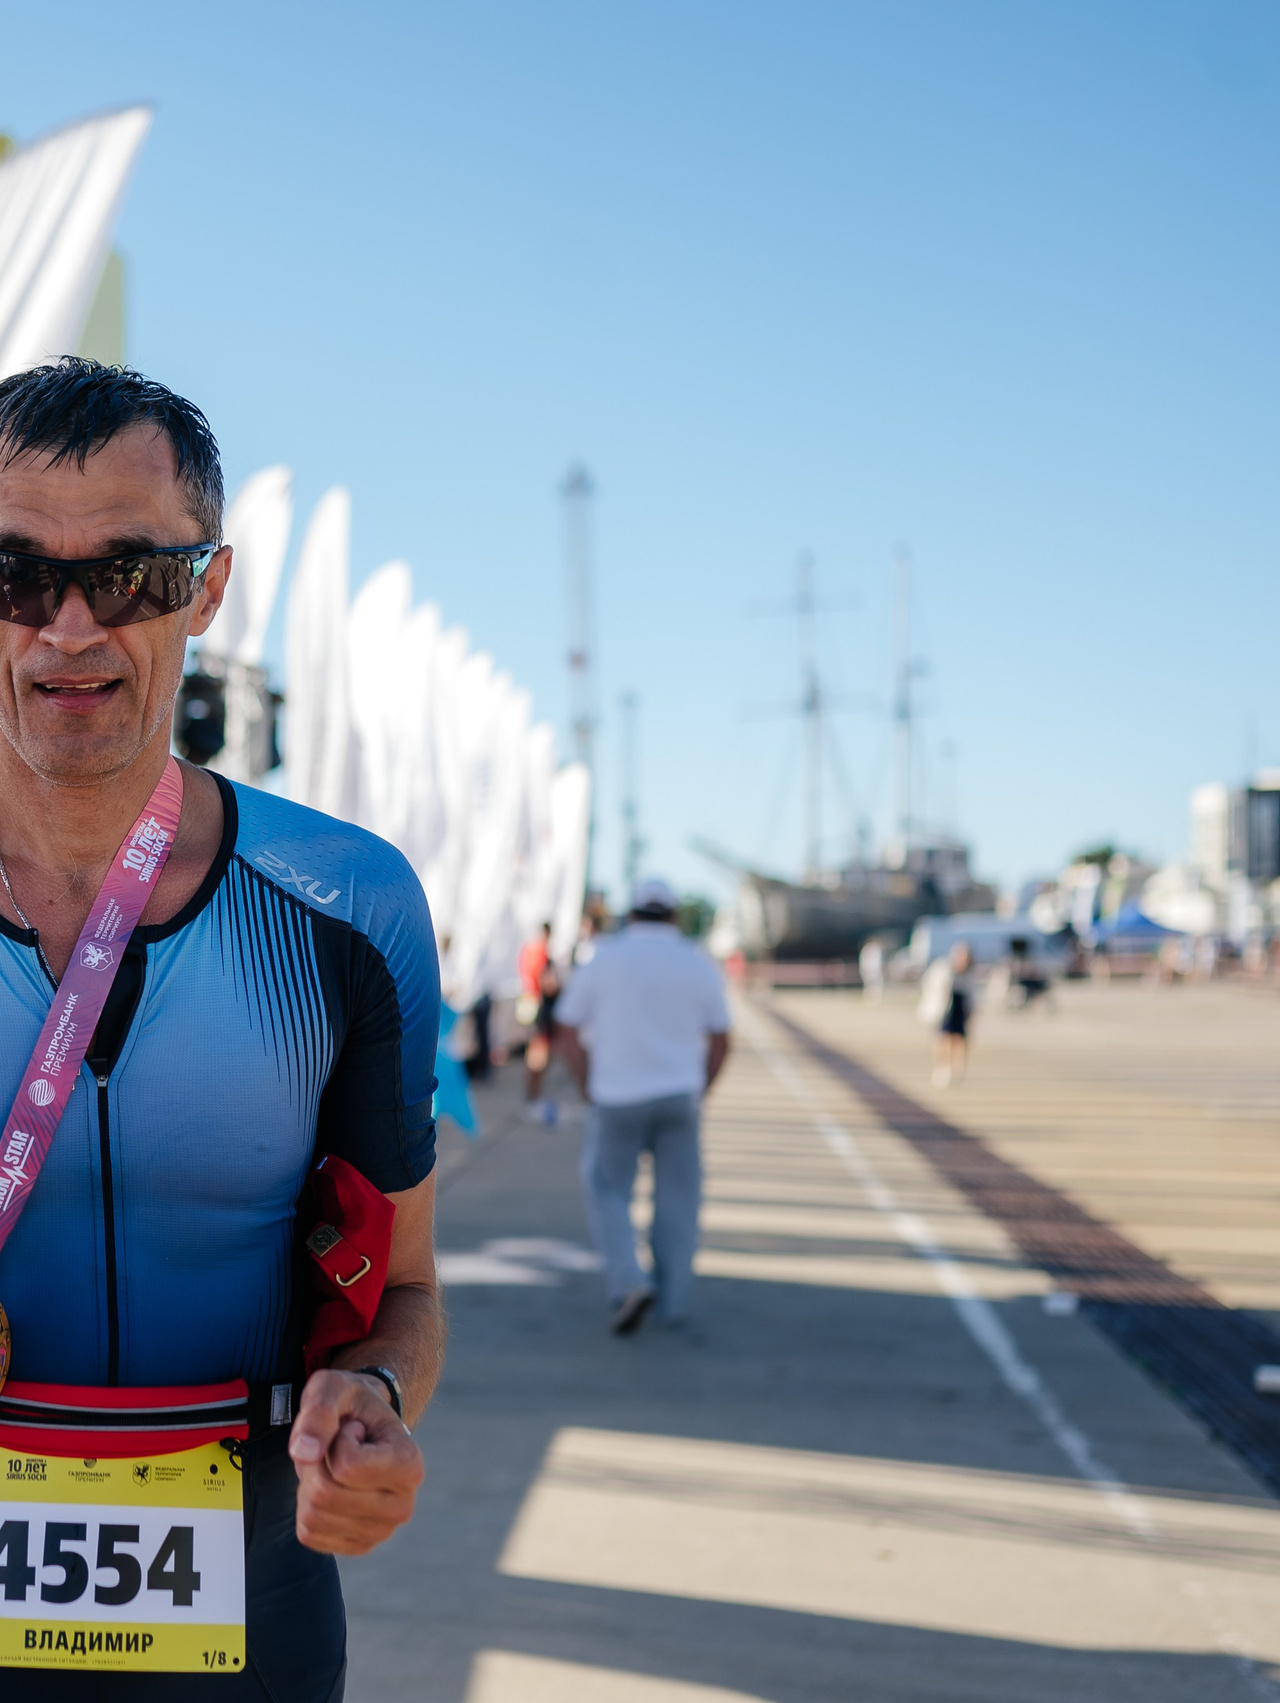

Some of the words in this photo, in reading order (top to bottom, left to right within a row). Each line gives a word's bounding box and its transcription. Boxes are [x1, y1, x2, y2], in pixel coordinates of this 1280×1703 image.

[122, 848, 147, 871] 10
[138, 854, 158, 883] SIRIUS
[153, 829, 169, 858] SOCHI
[253, 850, 341, 904] 2XU
[94, 898, 116, 938] ФЕДЕРАЛЬНАЯ
[100, 905, 120, 940] ТЕРРИТОРИЯ
[40, 992, 79, 1073] ГАЗПРОМБАНК
[50, 1022, 78, 1077] ПРЕМИУМ
[4, 1130, 29, 1165] STAR
[7, 1459, 22, 1472] 10
[27, 1473, 47, 1481] SOCHI
[203, 1478, 225, 1486] SIRIUS
[24, 1629, 154, 1655] ВЛАДИМИР
[202, 1650, 226, 1668] 1/8
